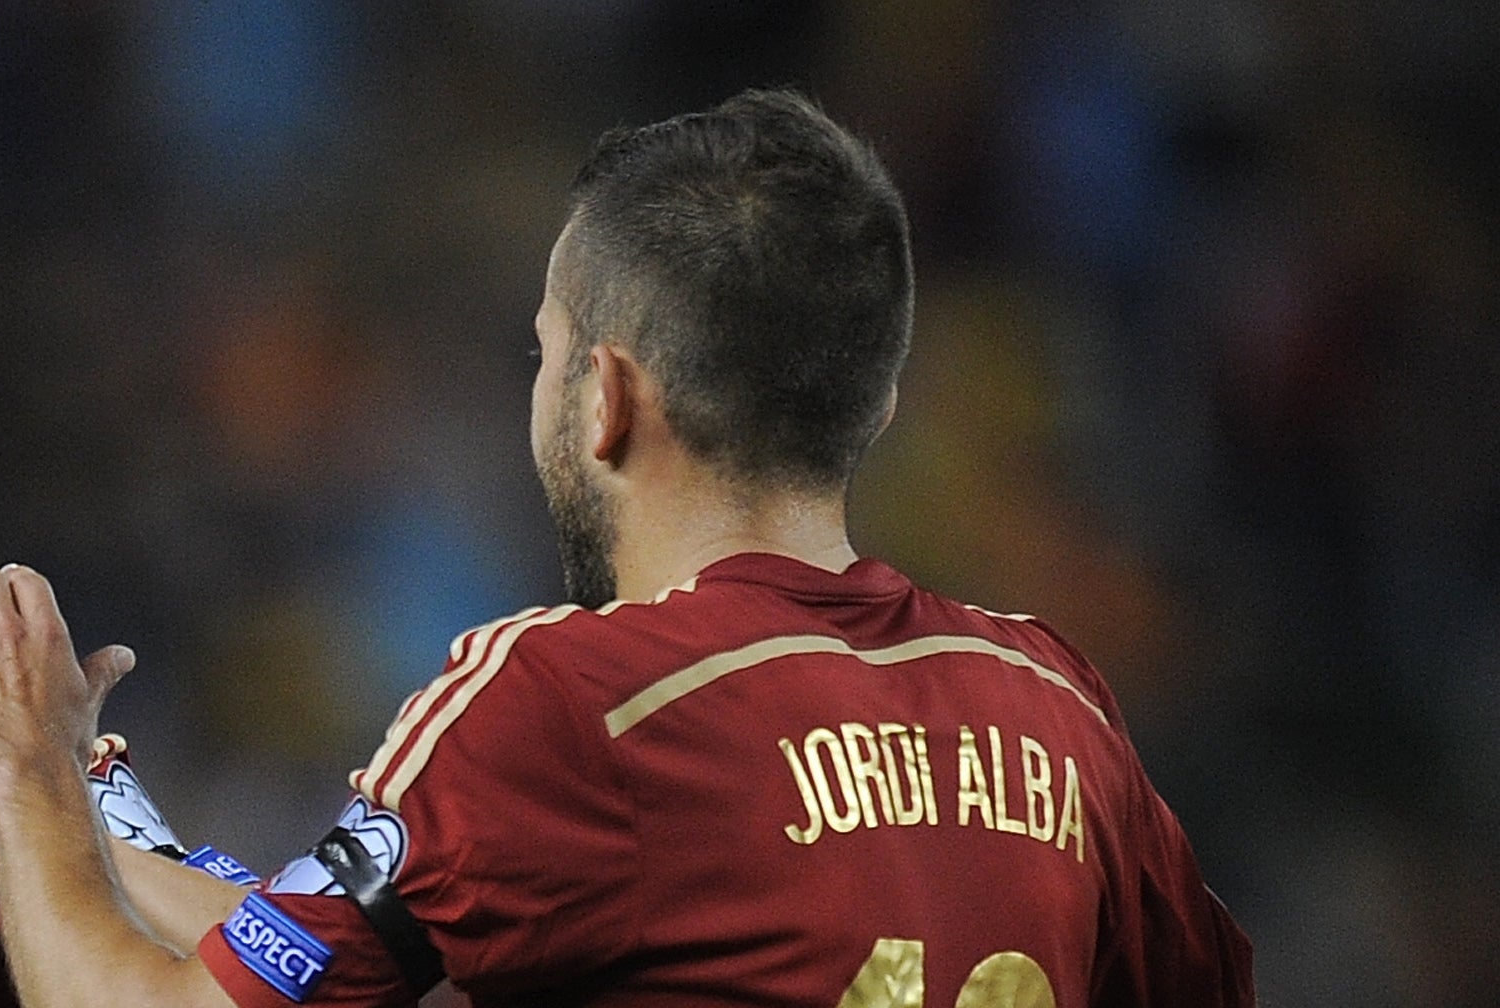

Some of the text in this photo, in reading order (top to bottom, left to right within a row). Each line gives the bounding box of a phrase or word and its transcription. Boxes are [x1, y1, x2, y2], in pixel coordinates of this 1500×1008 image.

[777, 721, 1085, 864] JORDI ALBA
[228, 907, 324, 986] RESPECT
